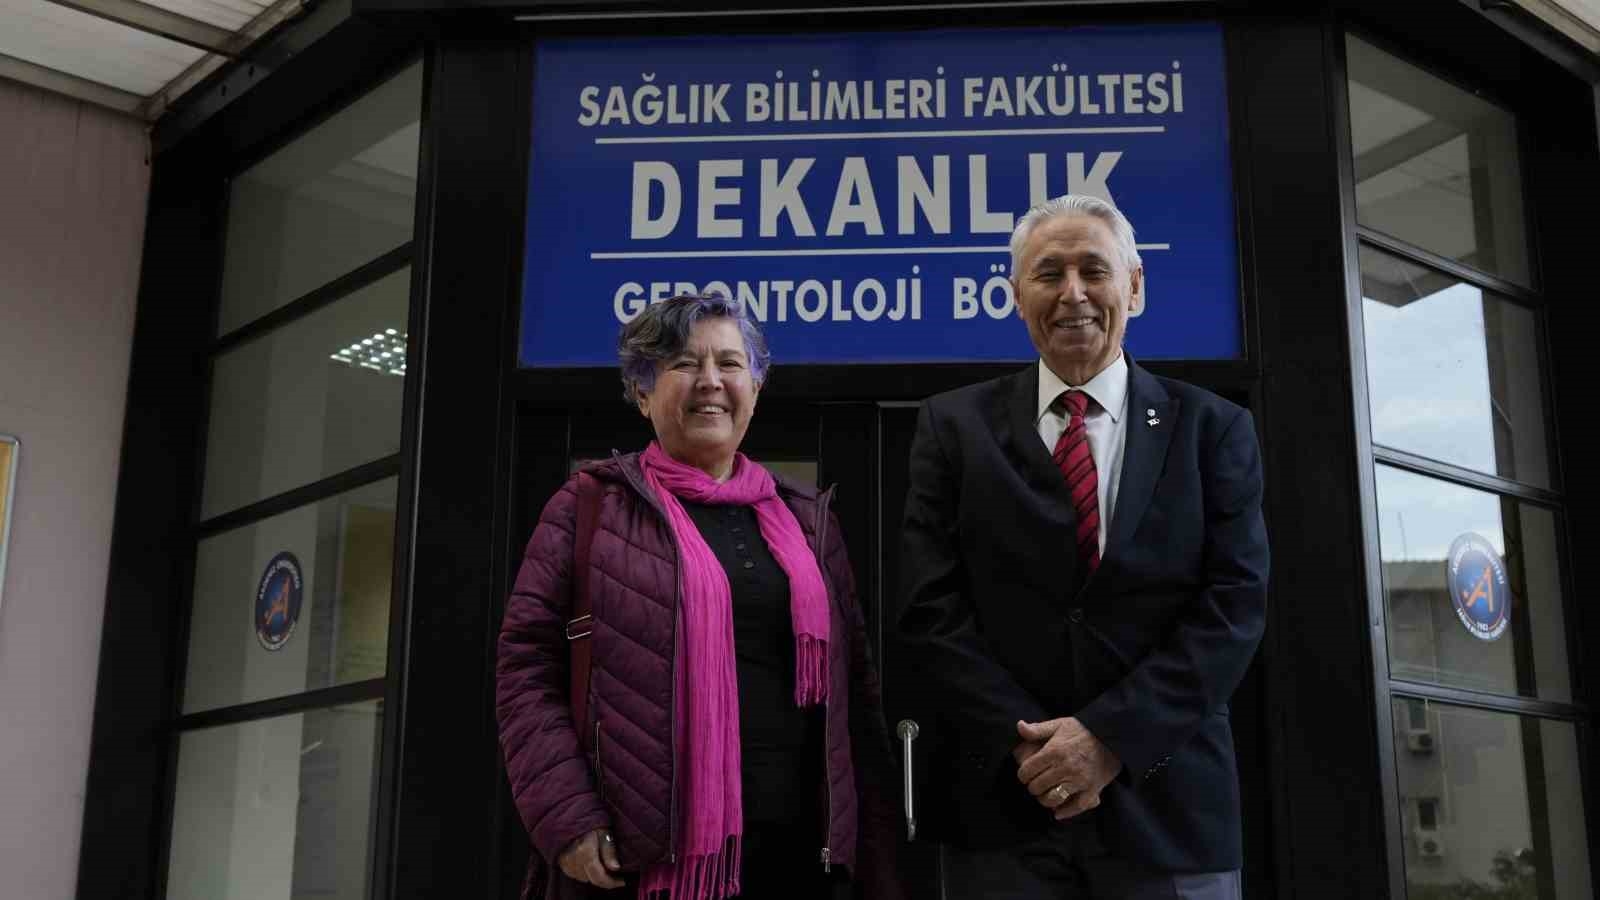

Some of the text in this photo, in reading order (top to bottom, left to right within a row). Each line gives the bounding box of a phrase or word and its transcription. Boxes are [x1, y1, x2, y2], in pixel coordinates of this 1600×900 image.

[578, 62, 1184, 127] SAĞLIK BİLİMLERİ FAKÜLTESİ
[631, 152, 1123, 240] DEKANLIK
